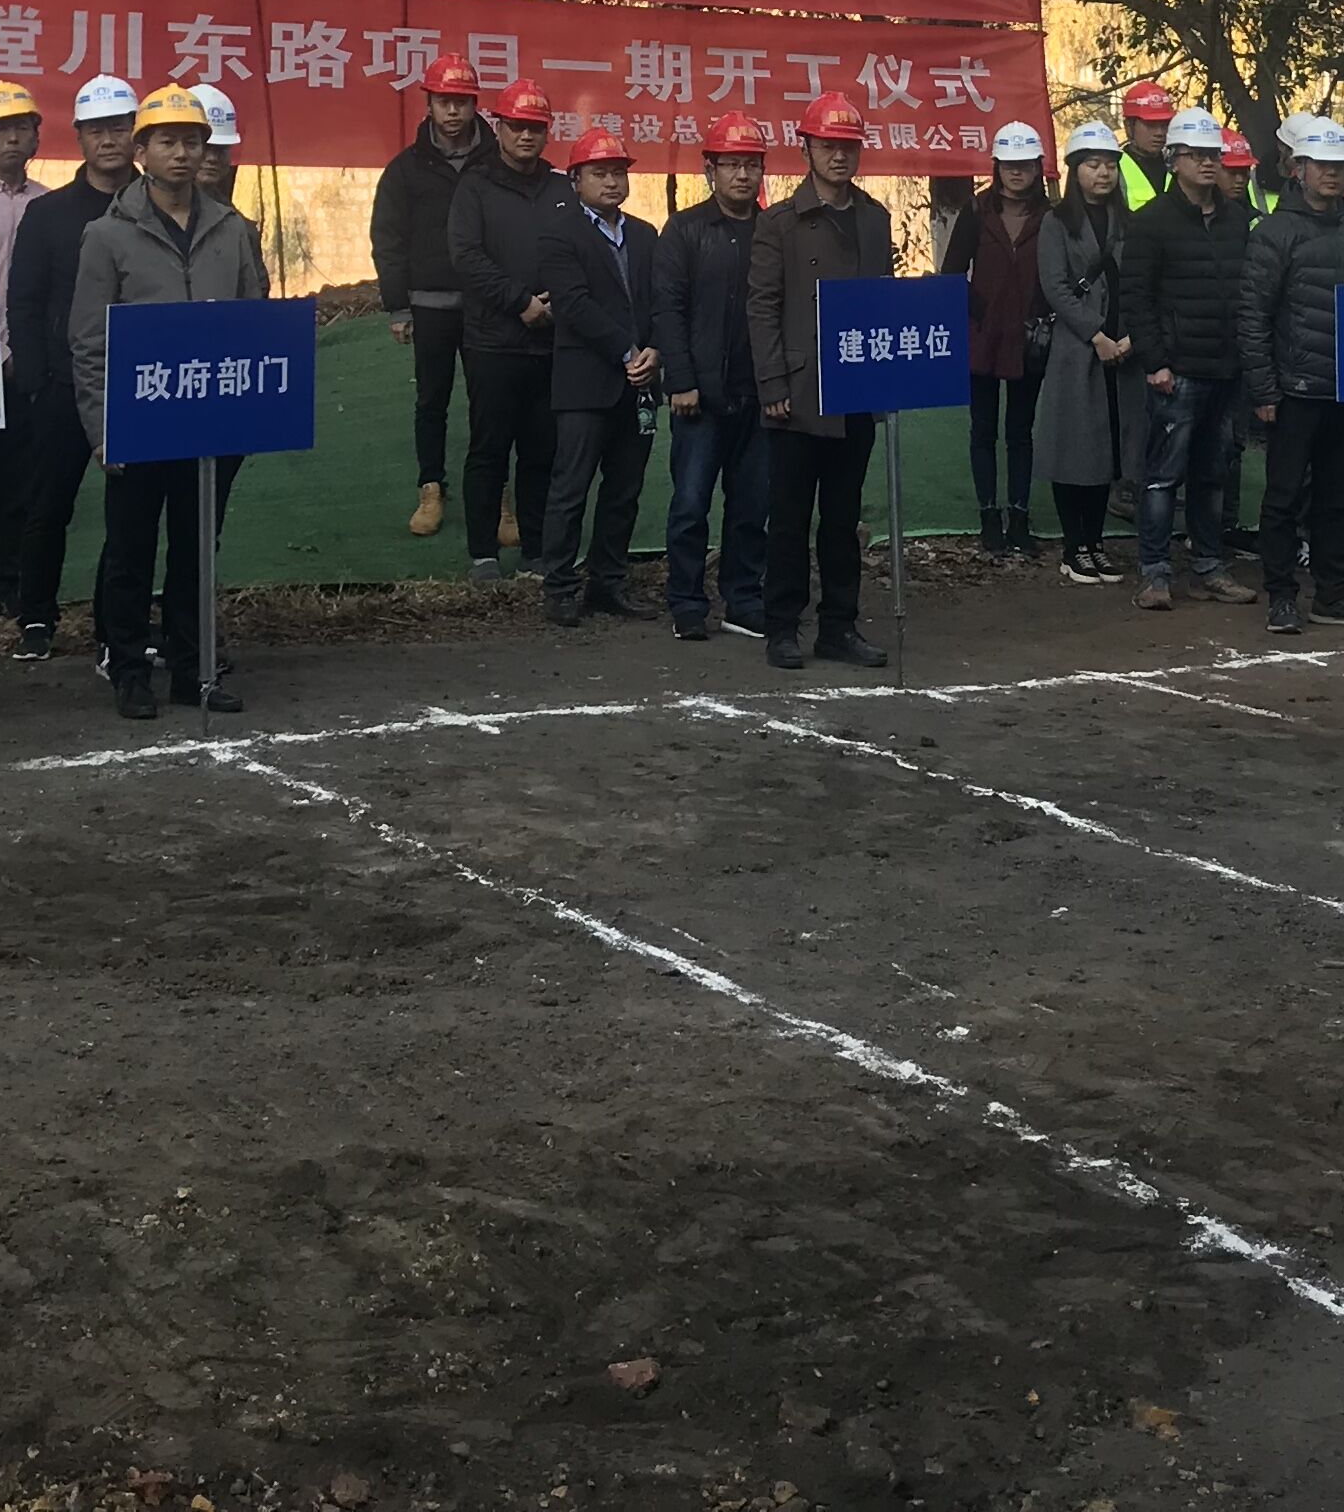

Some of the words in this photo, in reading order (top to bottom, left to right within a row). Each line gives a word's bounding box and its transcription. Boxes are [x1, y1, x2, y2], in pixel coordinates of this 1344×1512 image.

[838, 324, 952, 364] 建设单位
[134, 355, 290, 402] 政府部门
